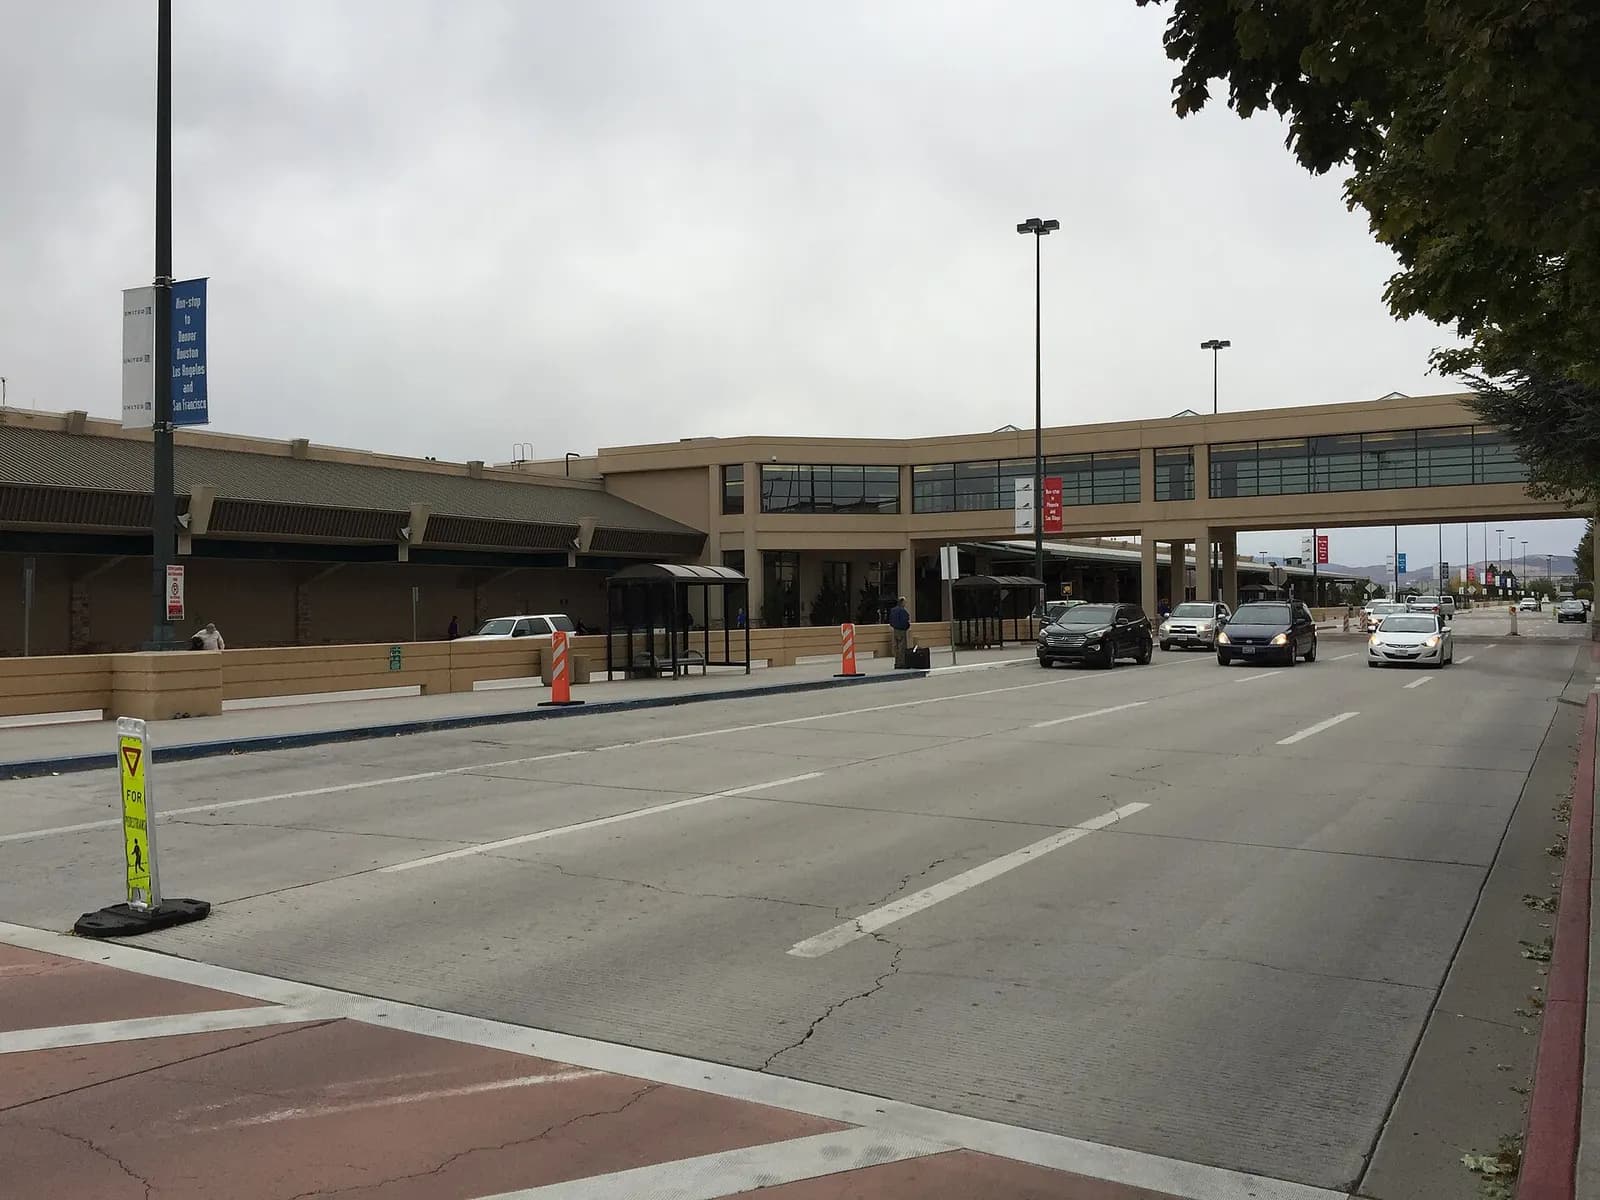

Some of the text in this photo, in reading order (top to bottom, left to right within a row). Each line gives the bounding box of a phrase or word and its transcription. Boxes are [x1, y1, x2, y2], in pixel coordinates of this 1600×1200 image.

[184, 314, 191, 325] to
[178, 331, 197, 343] Denver
[177, 348, 198, 360] Houston
[172, 363, 205, 378] Los Angeles
[183, 381, 194, 393] and
[173, 398, 206, 411] San Francisco
[126, 789, 142, 803] FOR
